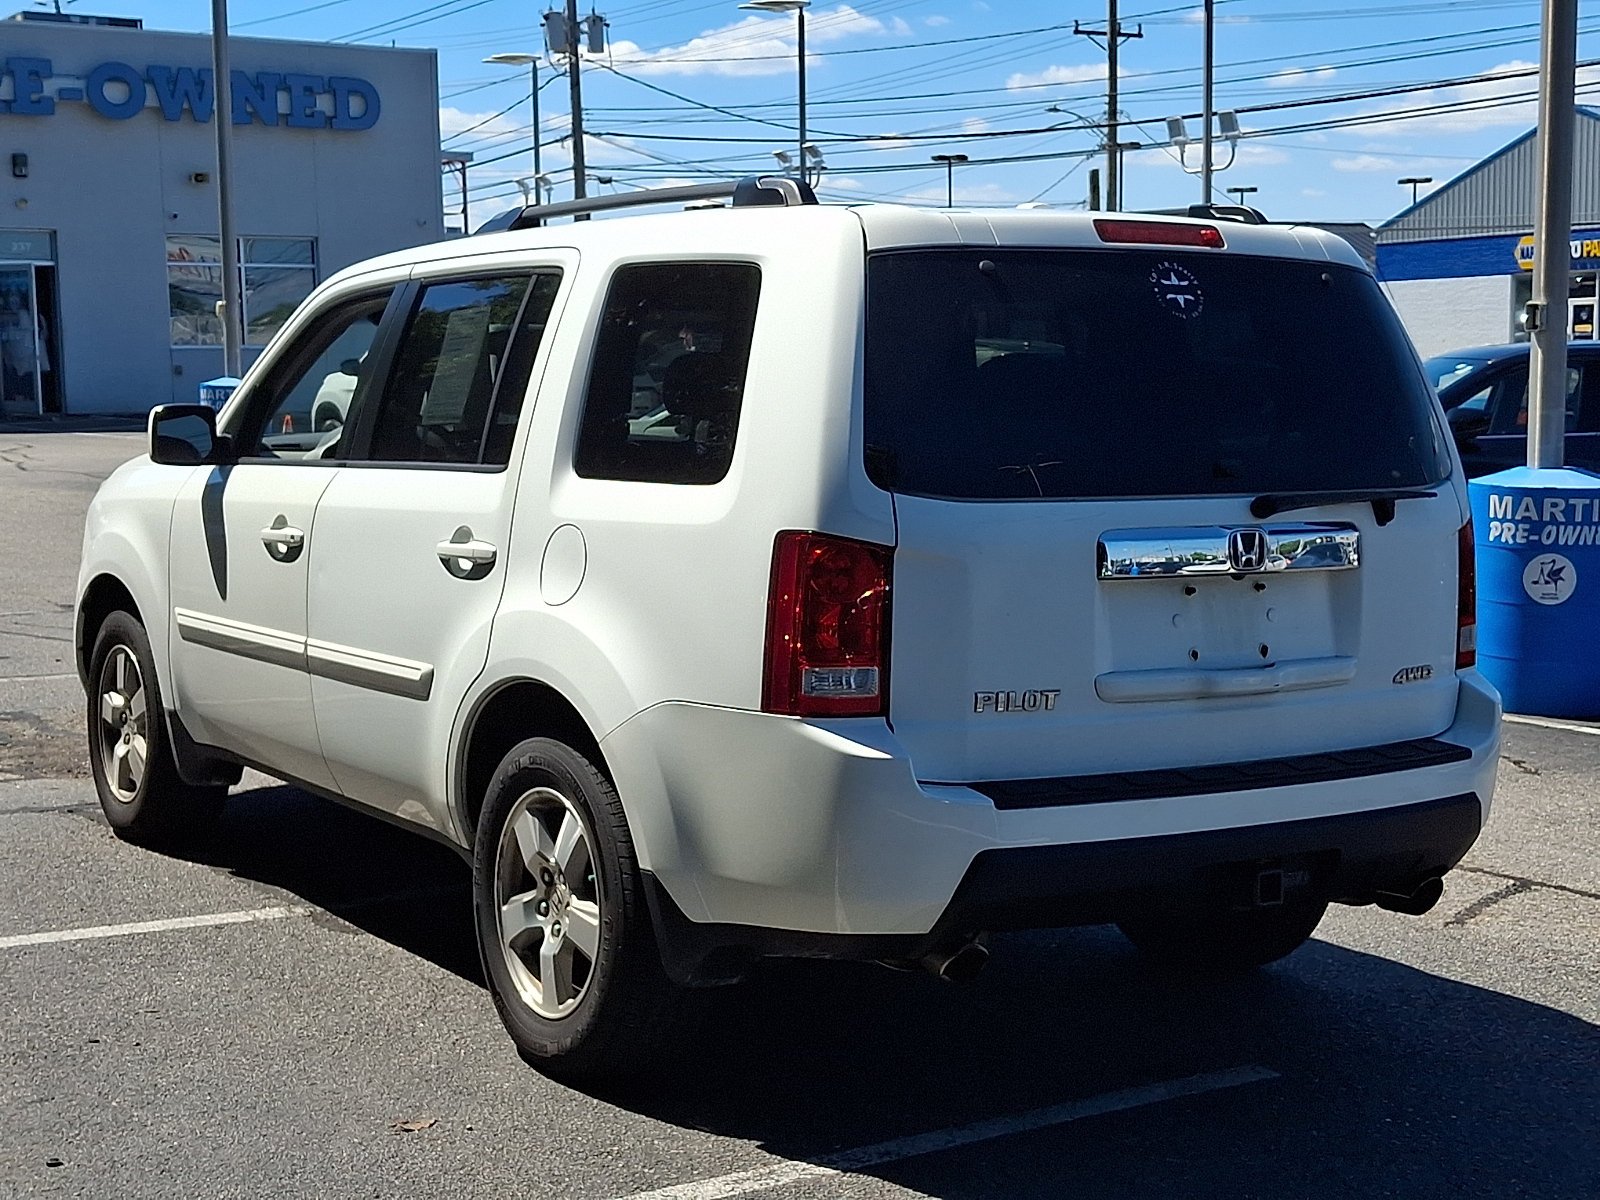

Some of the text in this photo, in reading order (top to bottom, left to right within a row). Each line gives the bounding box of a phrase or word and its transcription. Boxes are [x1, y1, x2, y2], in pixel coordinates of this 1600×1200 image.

[0, 57, 381, 131] E-OWNED
[1392, 664, 1434, 685] 4WD
[974, 689, 1061, 713] PILOT
